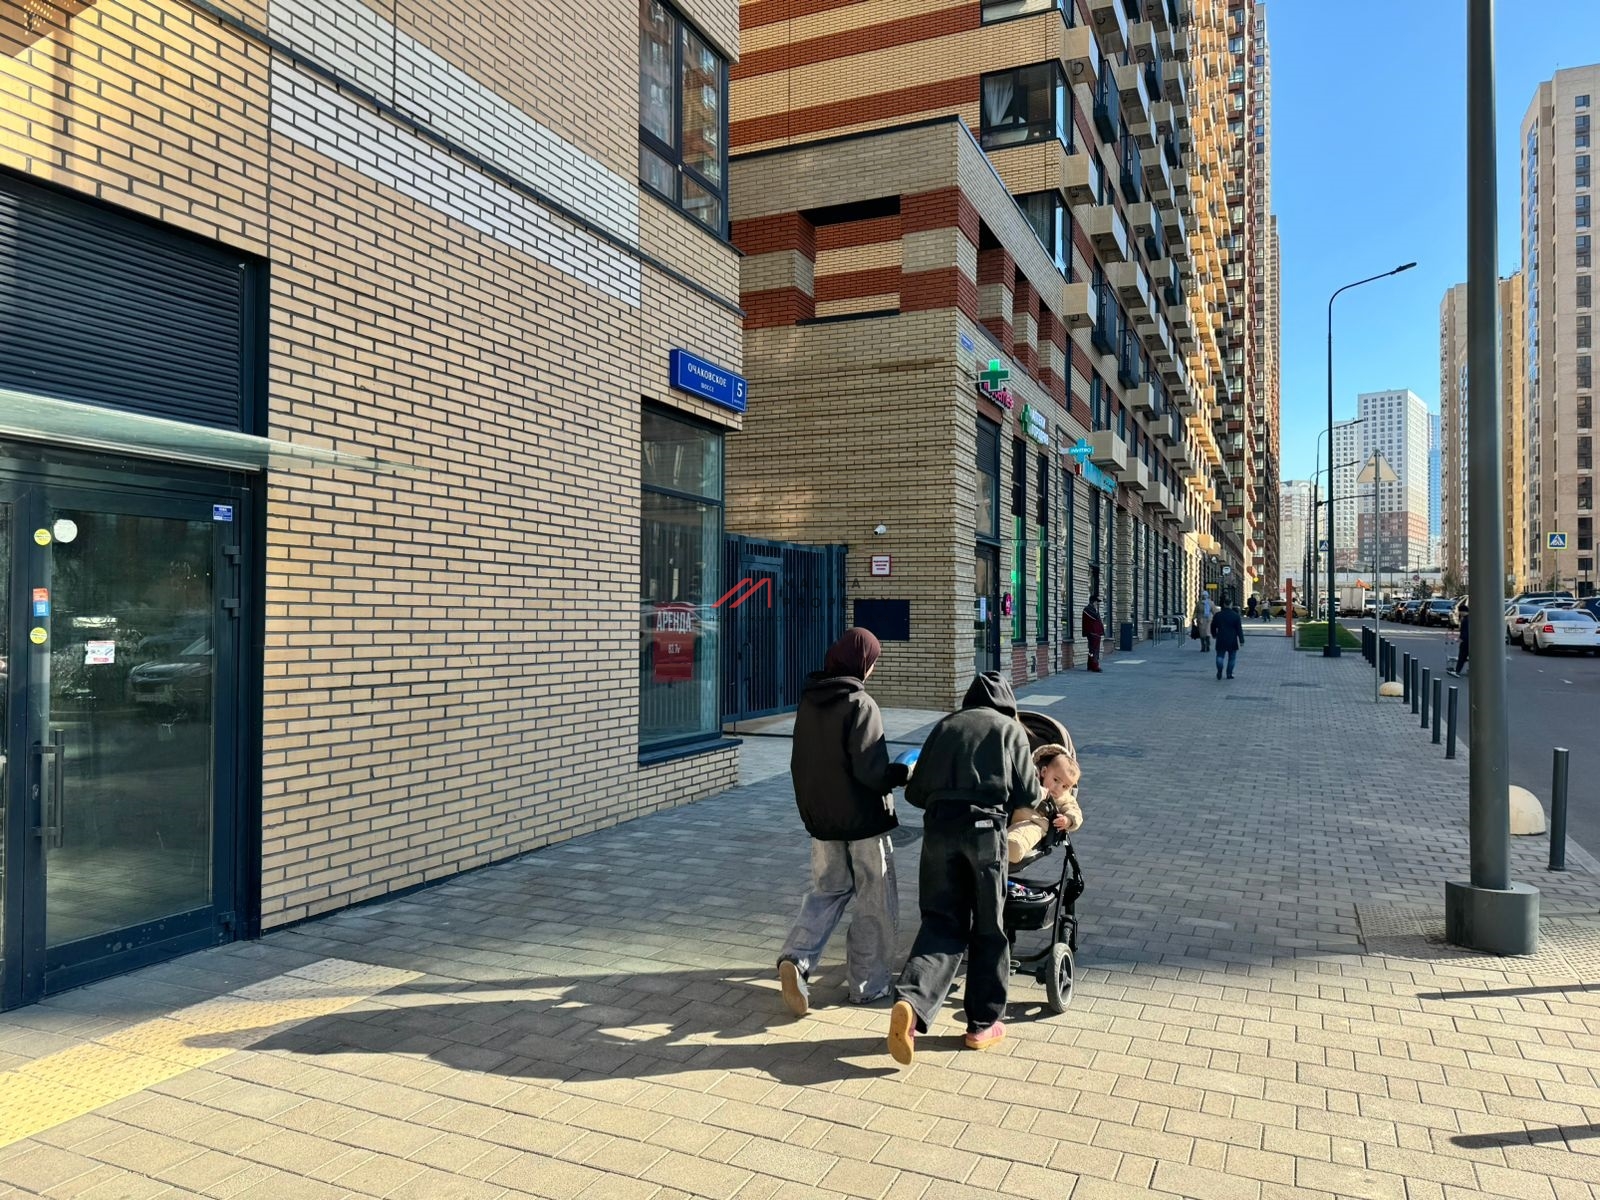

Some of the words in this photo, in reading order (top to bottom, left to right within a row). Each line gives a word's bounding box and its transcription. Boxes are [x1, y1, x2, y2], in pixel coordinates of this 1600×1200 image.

[687, 362, 727, 388] ОЧАКОВСКОЕ
[736, 382, 743, 398] 5
[656, 611, 692, 634] АРЕНДА
